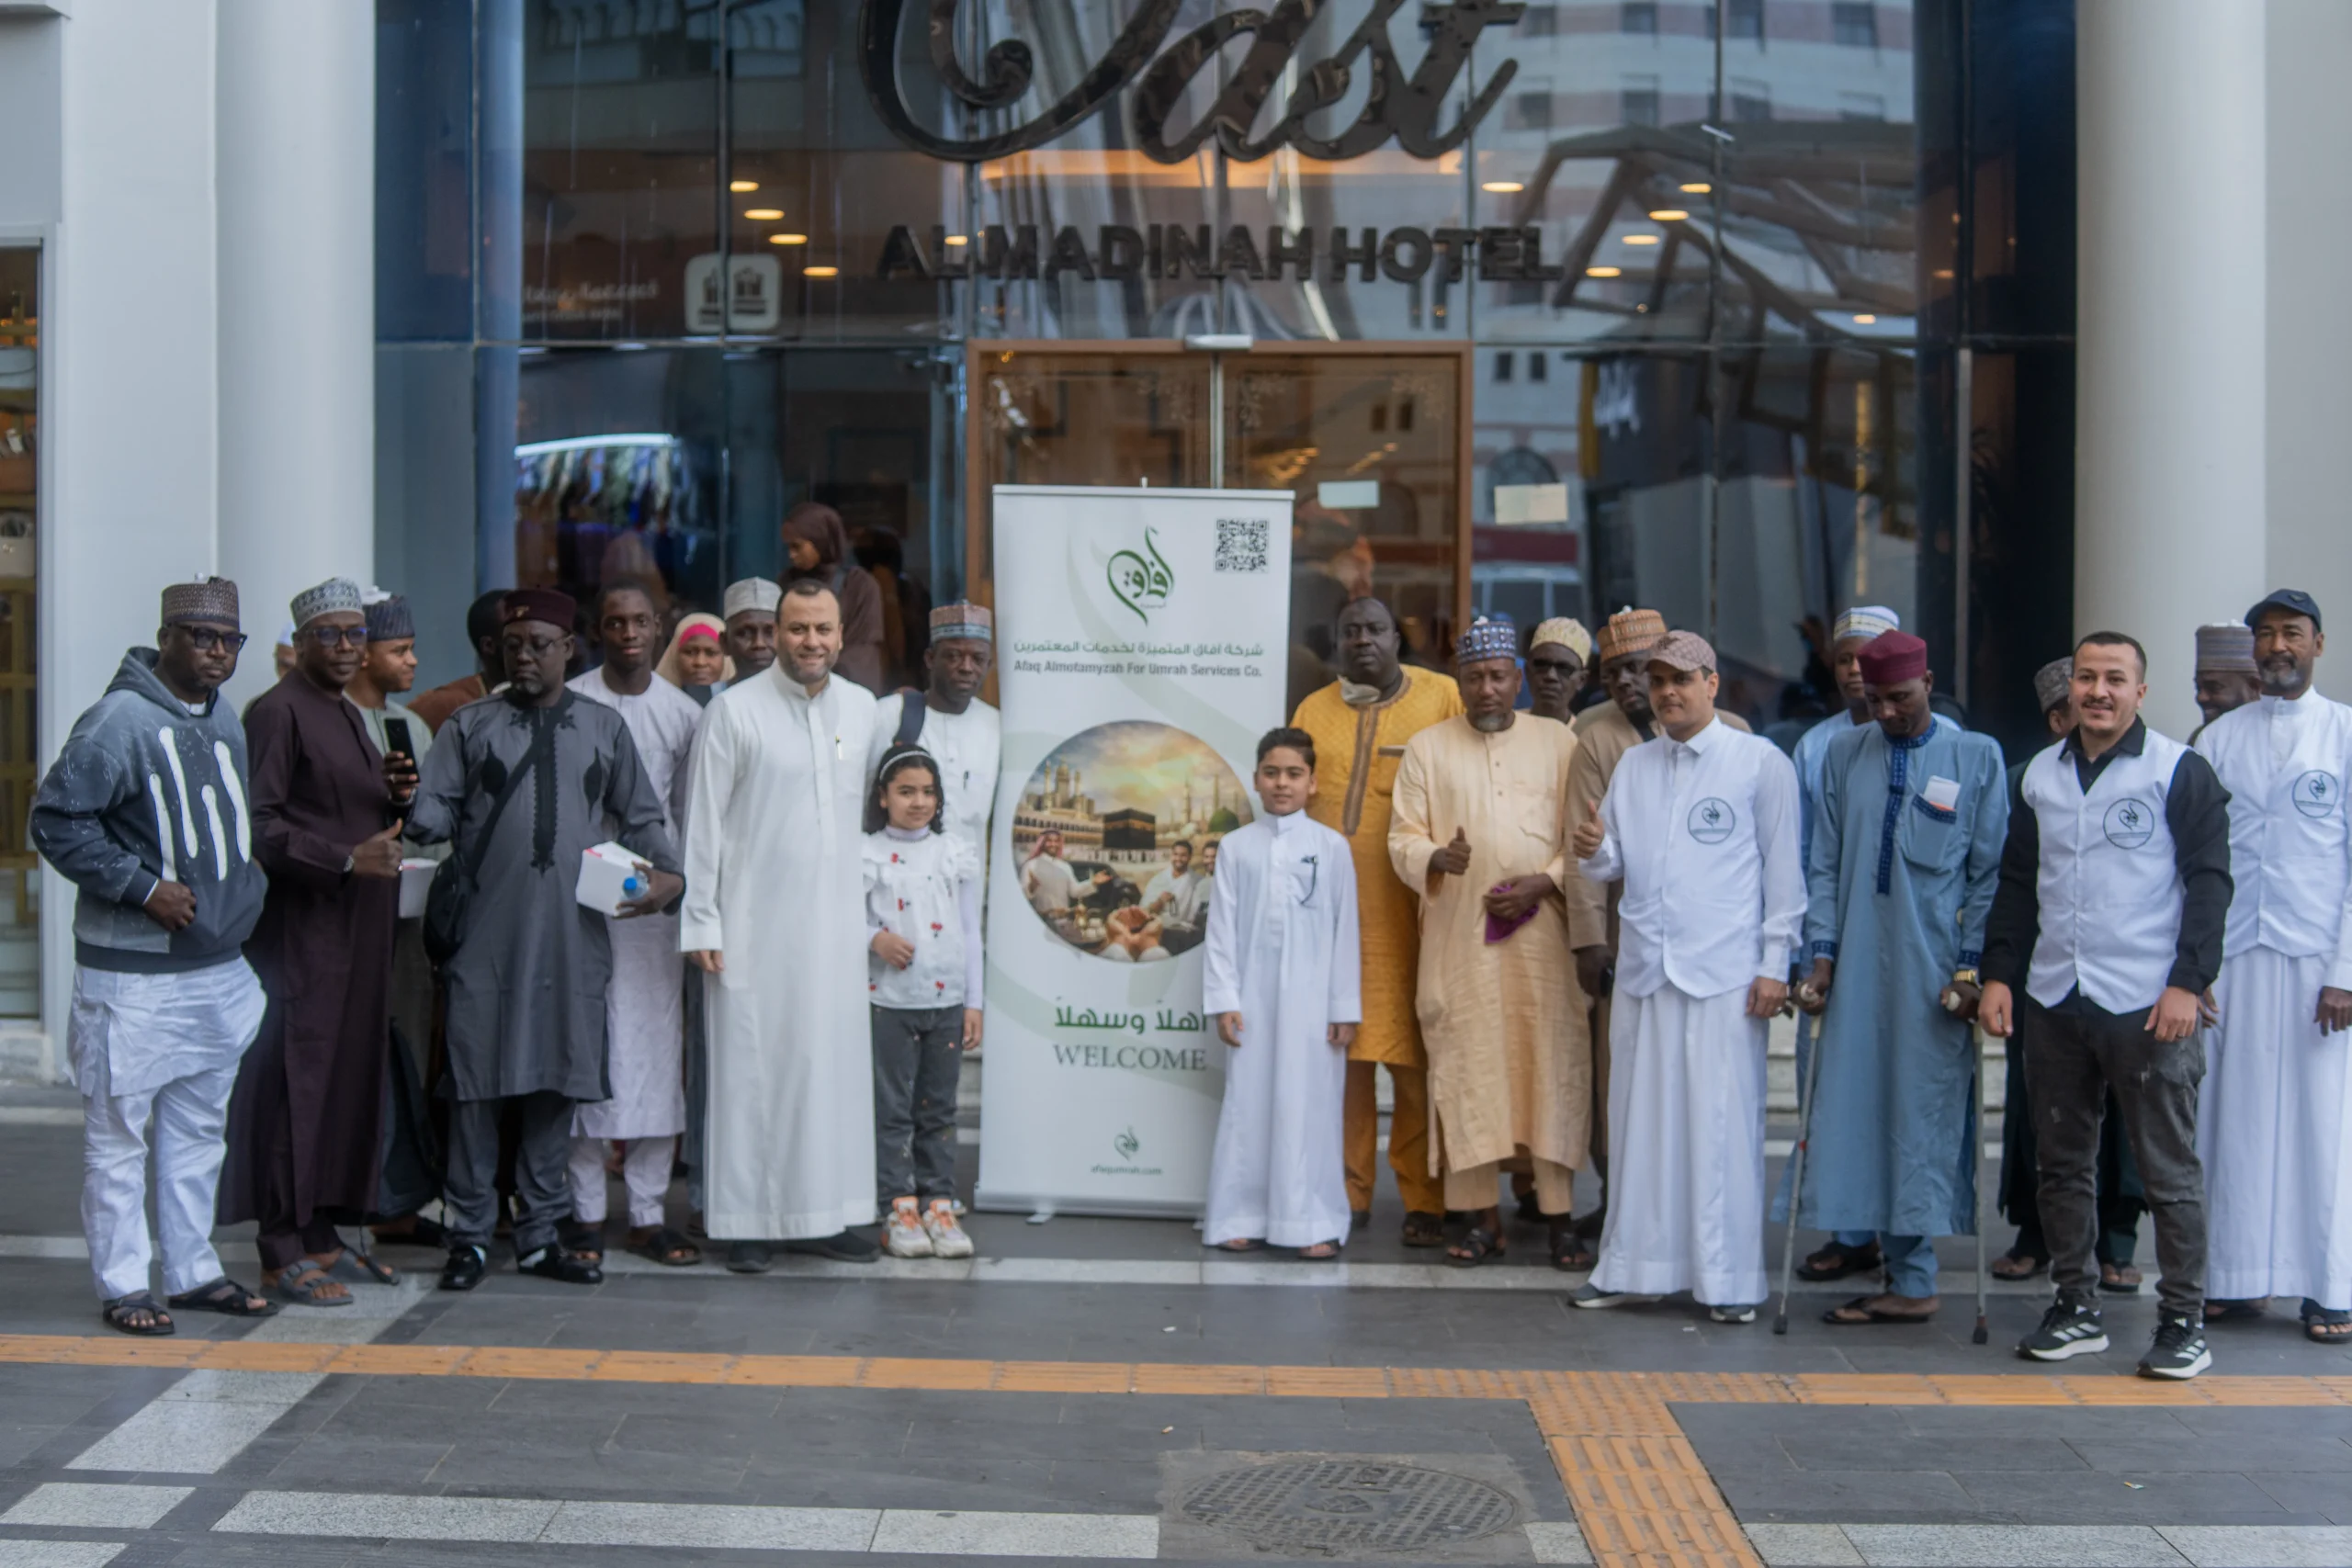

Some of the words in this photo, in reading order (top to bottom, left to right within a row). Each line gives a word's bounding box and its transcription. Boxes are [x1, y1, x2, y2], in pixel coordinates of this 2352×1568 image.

[982, 223, 1313, 281] MADINAH
[1332, 226, 1564, 283] HOTEL
[1013, 640, 1079, 653] المعتمرين
[1082, 640, 1135, 654] لخدمات
[1137, 640, 1190, 657] المتميزة
[1224, 643, 1263, 658] شركة
[1126, 662, 1146, 674] For
[1148, 663, 1187, 676] Umrah
[1190, 663, 1241, 678] Services
[1243, 665, 1262, 678] Co.
[1053, 1044, 1207, 1071] WELCOME
